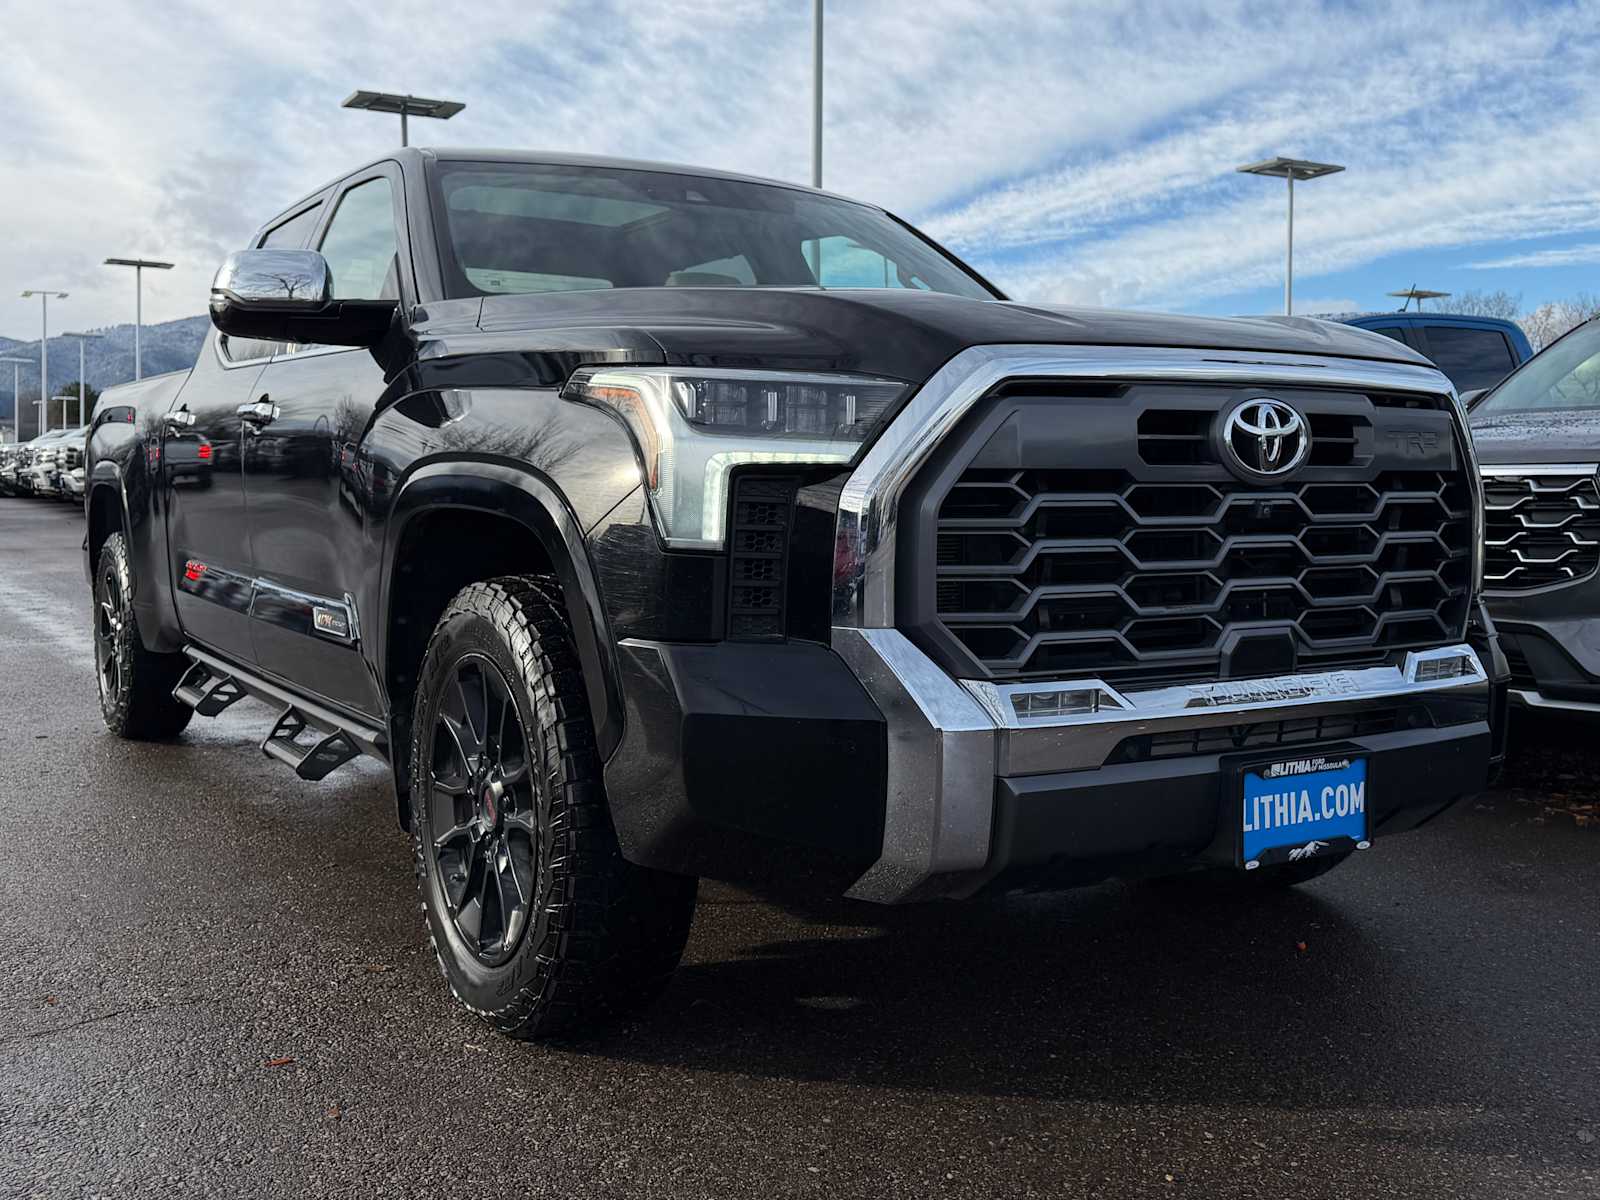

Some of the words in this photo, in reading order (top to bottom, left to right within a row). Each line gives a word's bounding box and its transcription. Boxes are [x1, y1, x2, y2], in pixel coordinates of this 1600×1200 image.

[1186, 672, 1361, 707] TUNDRA
[1280, 760, 1311, 776] LITHIA
[1243, 781, 1365, 832] LITHIA.COM
